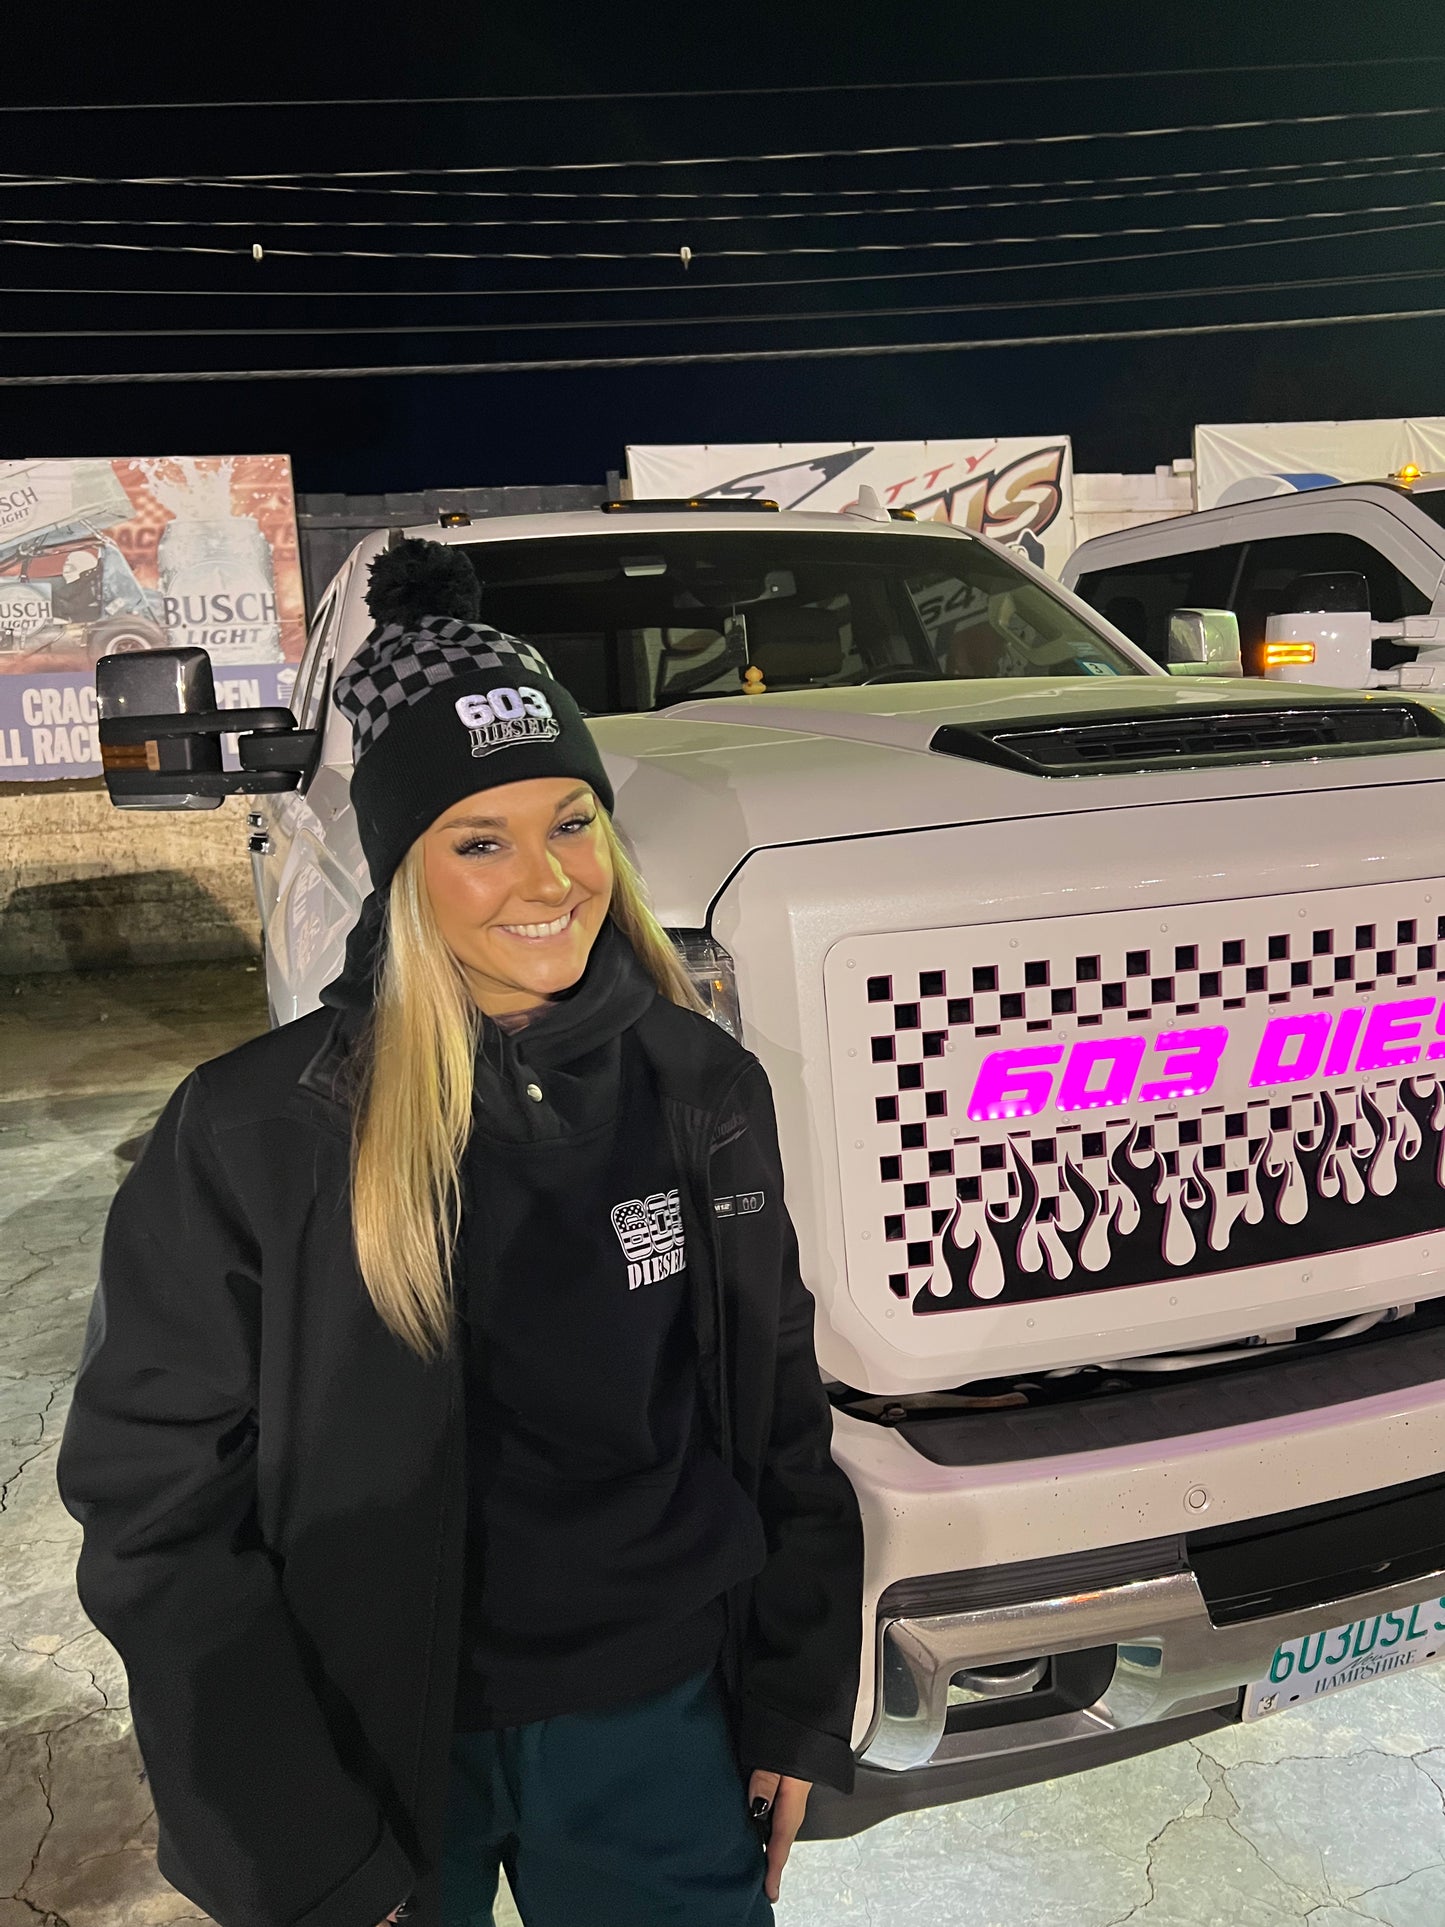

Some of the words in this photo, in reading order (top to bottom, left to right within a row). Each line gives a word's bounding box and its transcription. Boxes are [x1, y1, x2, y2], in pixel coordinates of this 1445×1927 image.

[0, 507, 29, 527] IGHT
[163, 593, 277, 628] BUSCH
[186, 629, 261, 645] LIGHT
[22, 686, 99, 726] CRAC
[455, 686, 552, 729] 603
[967, 1025, 1229, 1122] 603
[1248, 995, 1445, 1088] DIE
[627, 1247, 686, 1290] DIESEL
[1314, 1649, 1418, 1693] HAMPSHIRE
